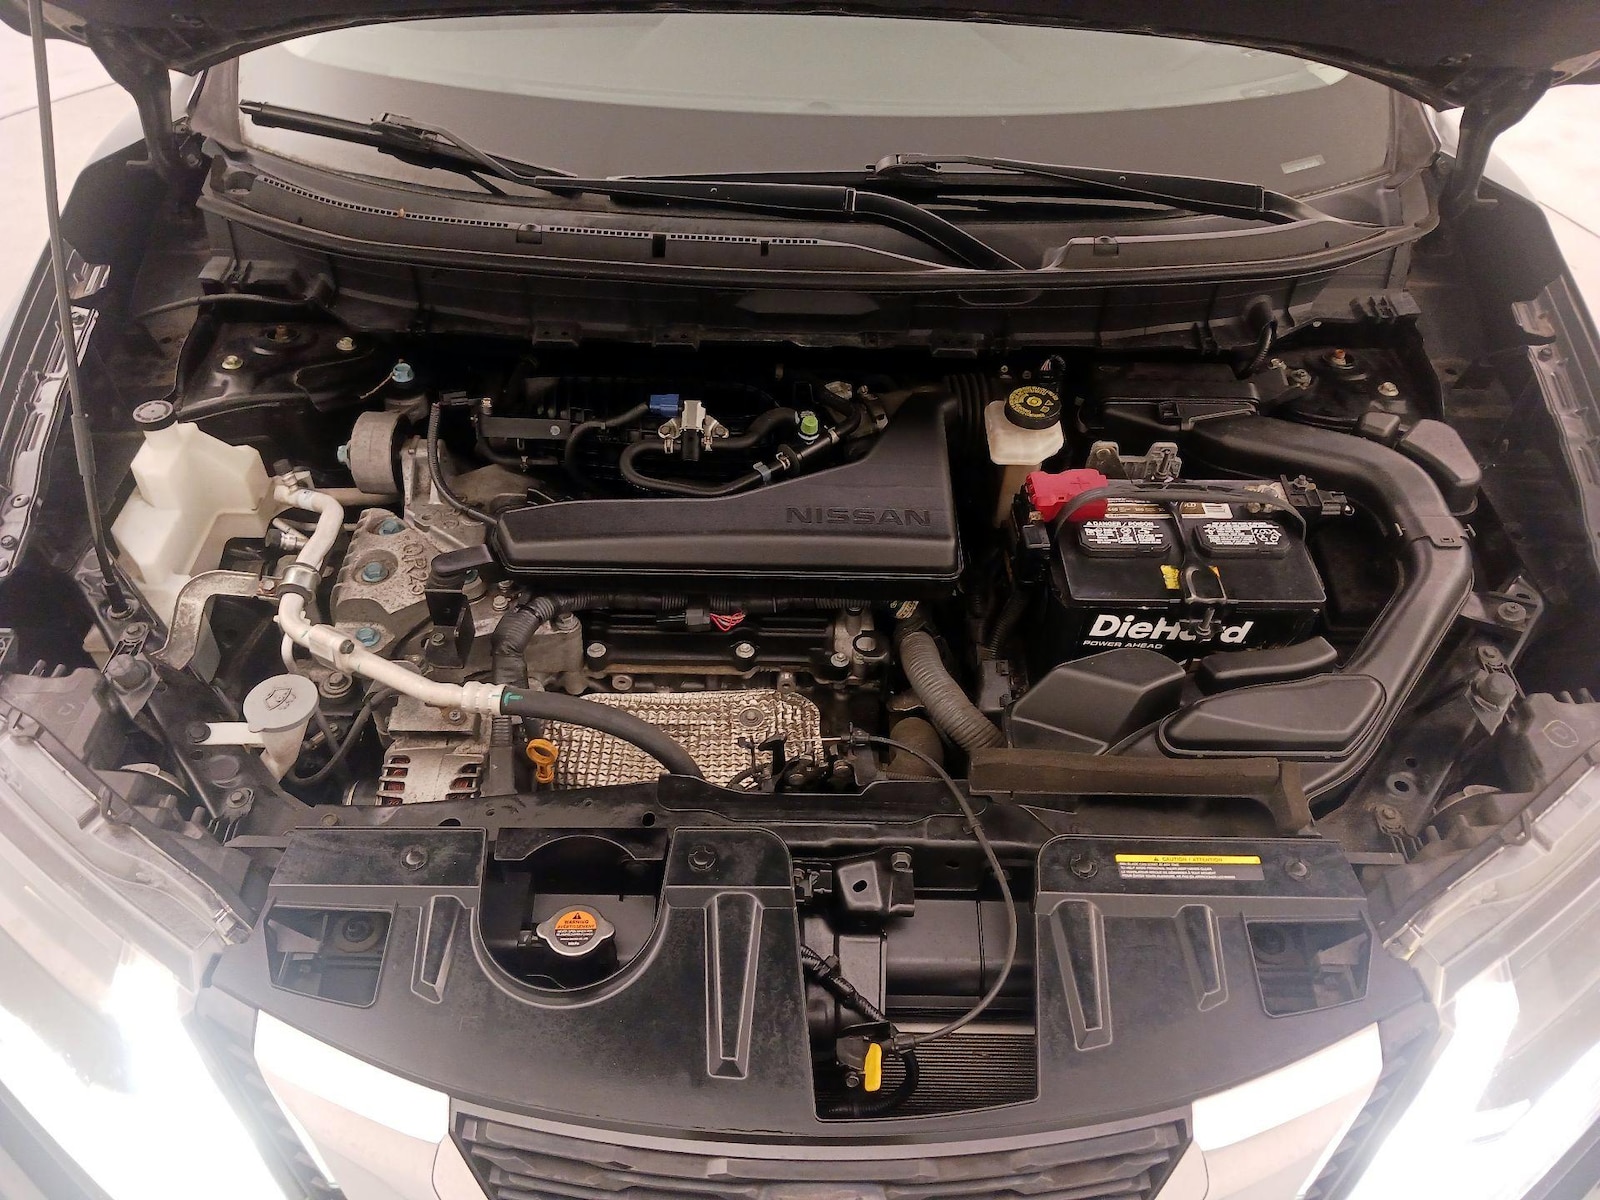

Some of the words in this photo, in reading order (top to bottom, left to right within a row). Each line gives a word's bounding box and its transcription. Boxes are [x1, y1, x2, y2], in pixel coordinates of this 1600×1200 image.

[786, 507, 931, 526] NISSAN
[1088, 614, 1254, 644] DieHad
[1083, 640, 1122, 648] POWER
[1125, 642, 1164, 650] AHEAD
